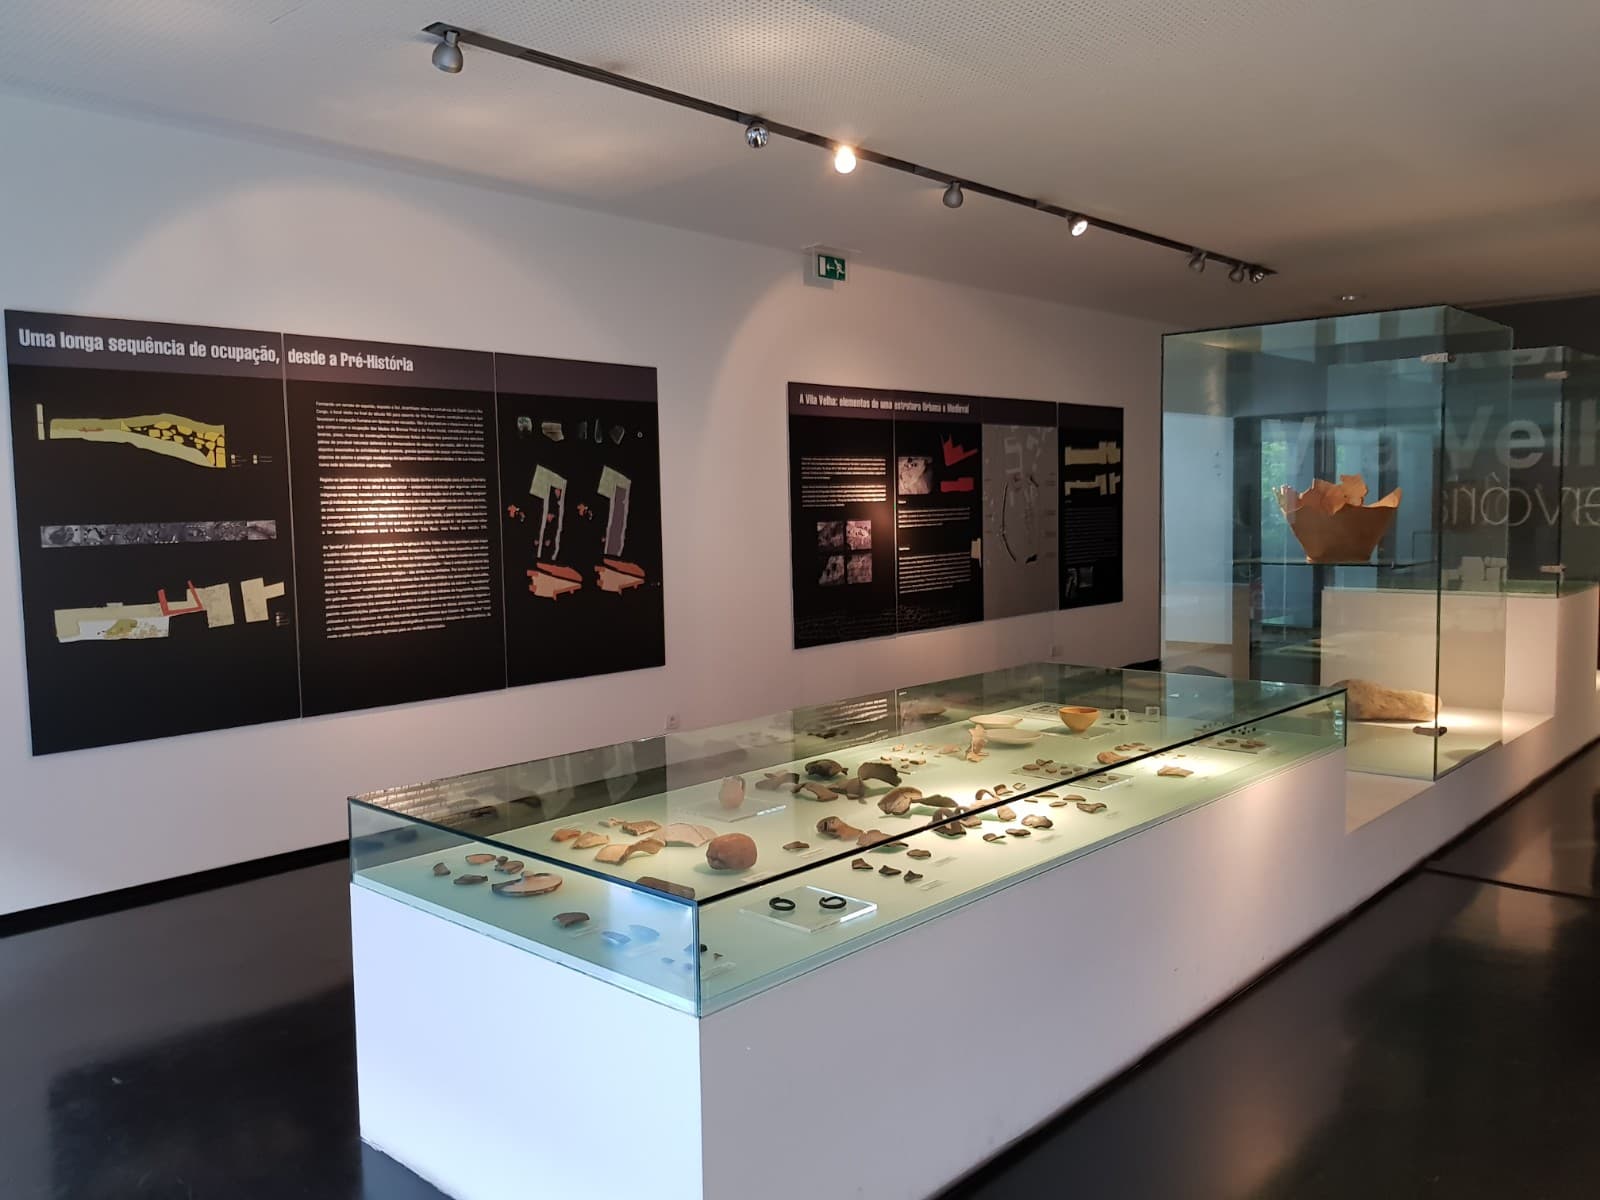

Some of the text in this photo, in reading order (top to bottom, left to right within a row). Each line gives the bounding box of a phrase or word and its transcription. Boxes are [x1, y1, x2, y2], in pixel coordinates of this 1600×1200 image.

[18, 328, 414, 373] Uma longa sequência de ocupação, desde a Pré-História
